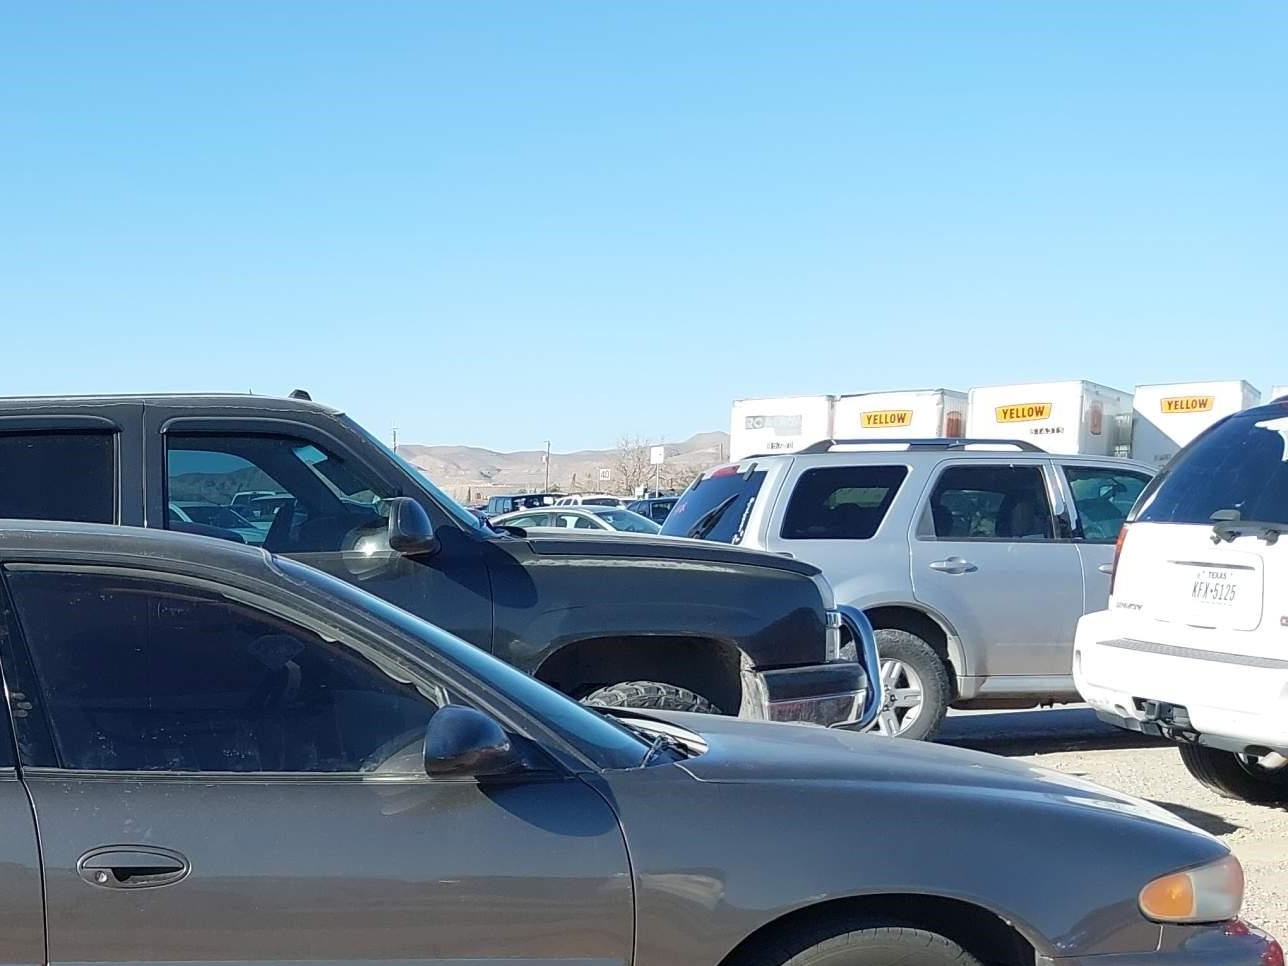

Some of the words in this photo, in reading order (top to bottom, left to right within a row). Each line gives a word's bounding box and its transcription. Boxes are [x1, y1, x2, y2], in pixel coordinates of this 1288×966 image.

[1167, 398, 1209, 411] YELLOW
[866, 412, 907, 425] YELLOW
[1002, 405, 1046, 420] YELLOW
[1208, 571, 1227, 580] TEXAS
